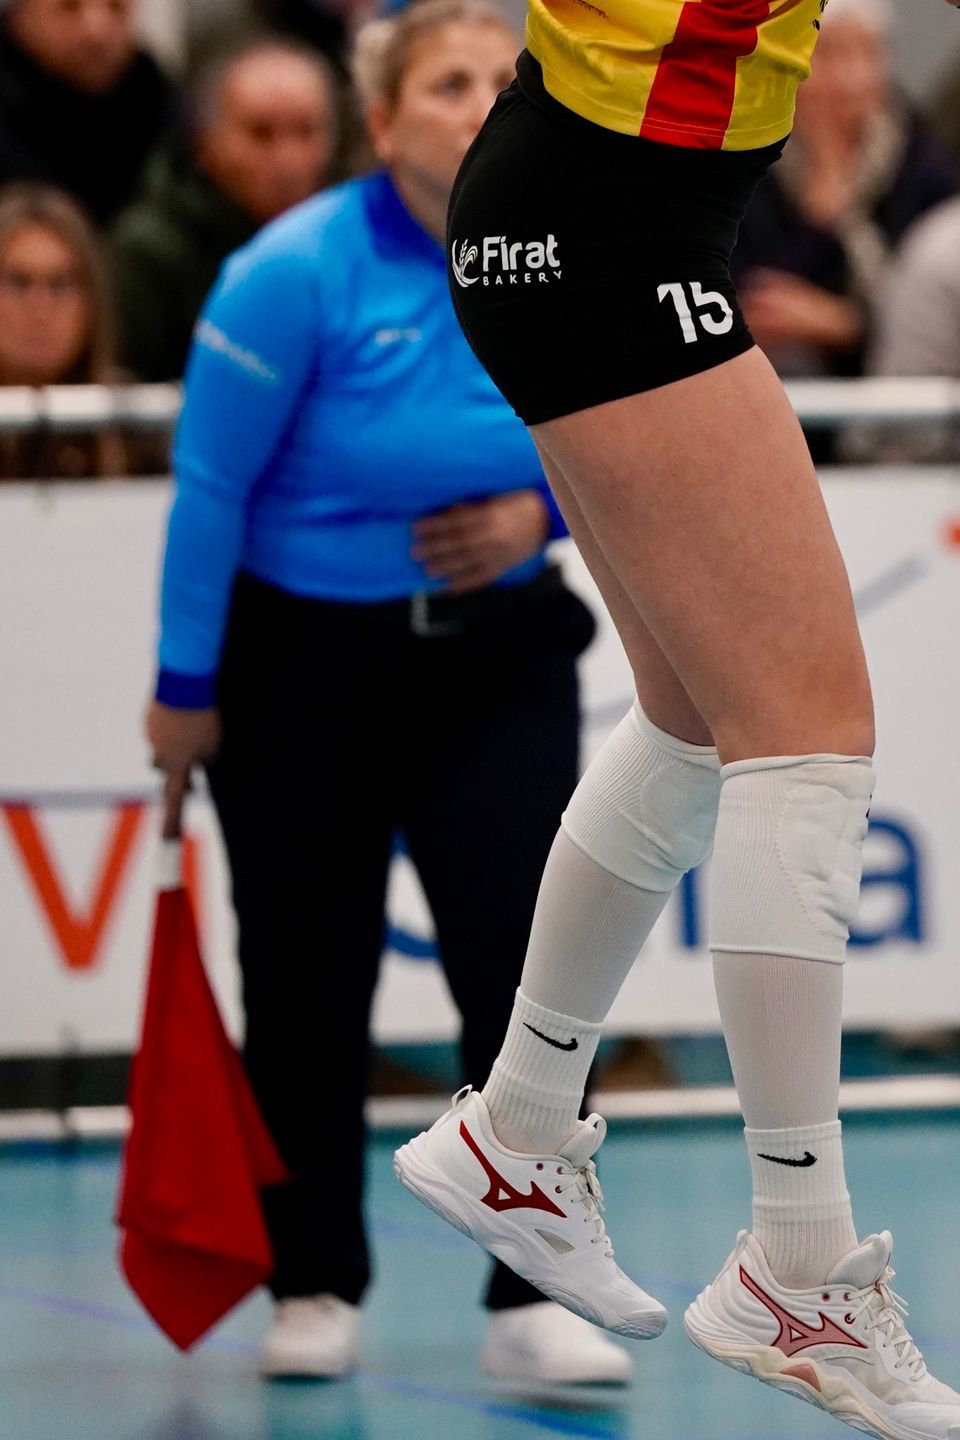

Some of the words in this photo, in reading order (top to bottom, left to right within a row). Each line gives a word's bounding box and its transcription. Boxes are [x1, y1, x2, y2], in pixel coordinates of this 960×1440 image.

[482, 234, 561, 272] Firat
[483, 270, 563, 287] BAKERY
[656, 281, 734, 344] 15
